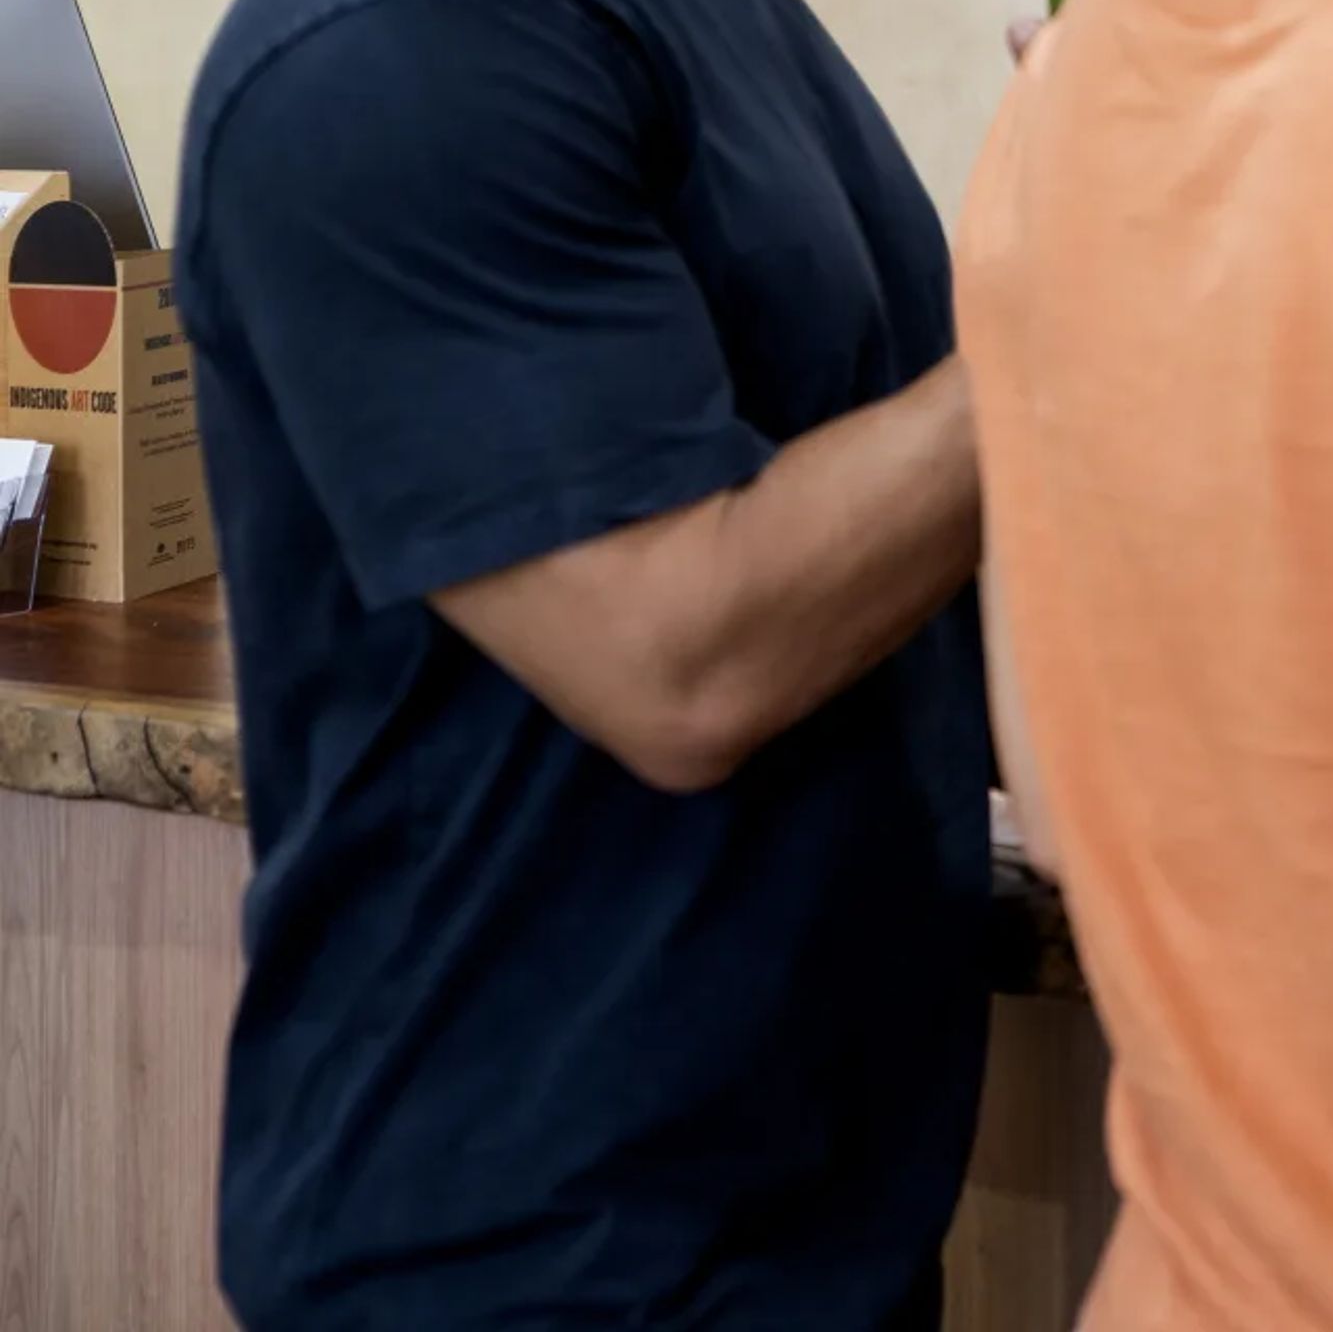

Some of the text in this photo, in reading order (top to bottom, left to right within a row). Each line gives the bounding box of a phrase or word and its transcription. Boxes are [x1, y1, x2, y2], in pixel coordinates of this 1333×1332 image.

[10, 386, 68, 410] INDIGENOUS
[71, 389, 89, 412] ART
[91, 390, 117, 414] CODE
